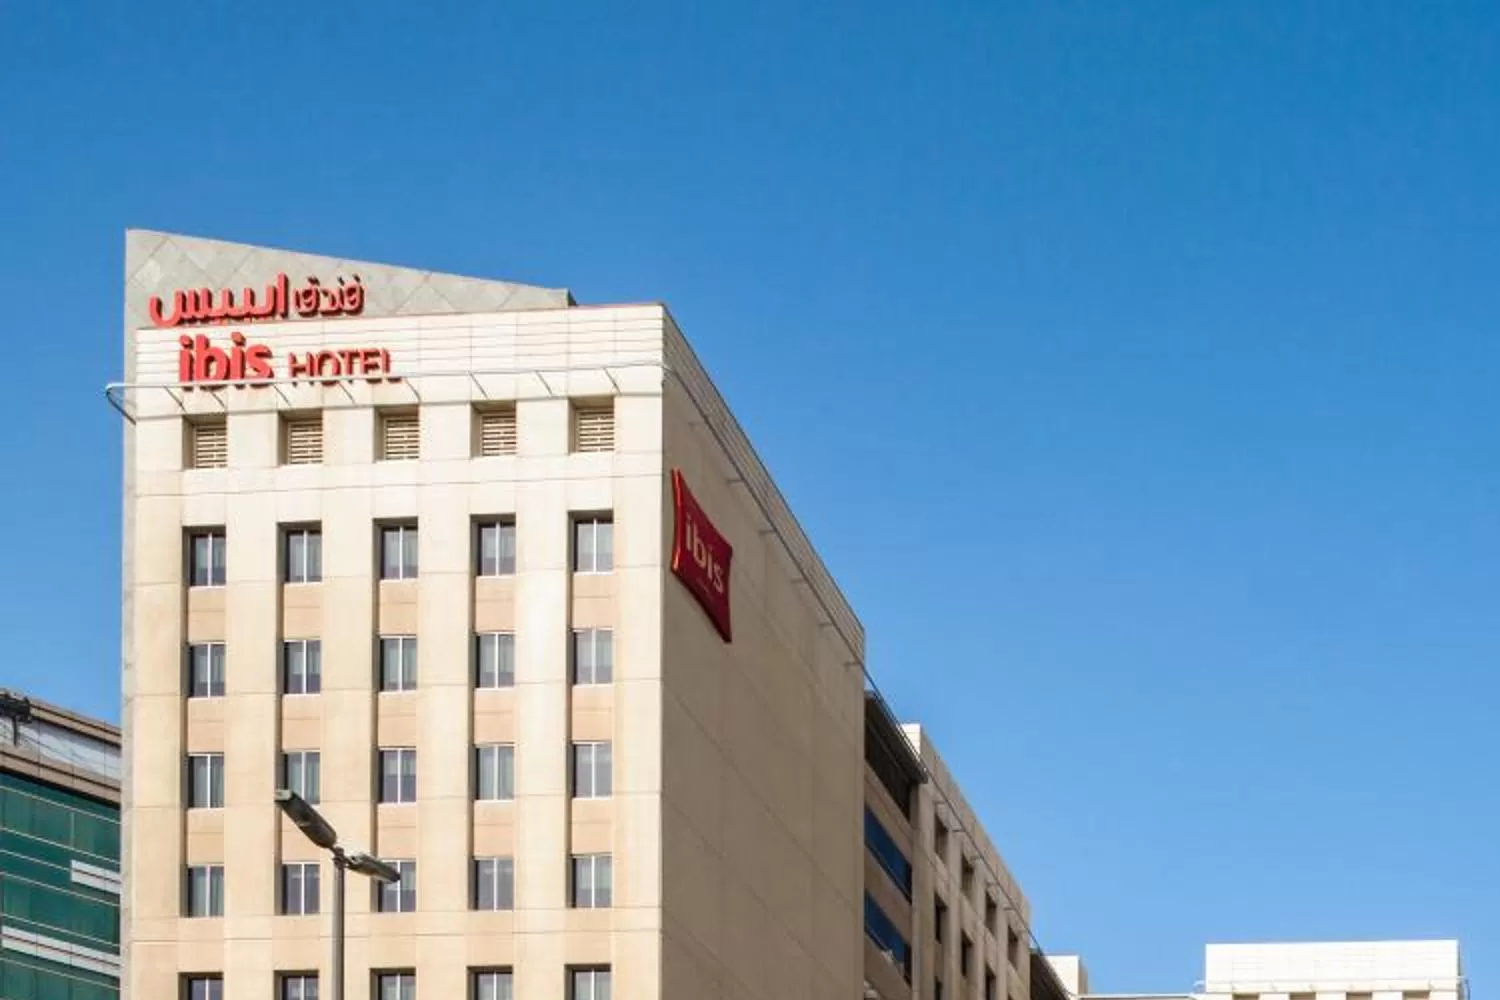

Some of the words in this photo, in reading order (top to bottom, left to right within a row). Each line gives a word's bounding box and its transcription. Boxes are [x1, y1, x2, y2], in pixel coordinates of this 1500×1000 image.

[293, 274, 365, 317] فندق
[179, 332, 274, 388] ibis
[288, 347, 402, 385] HOTEL
[685, 511, 724, 593] ibis
